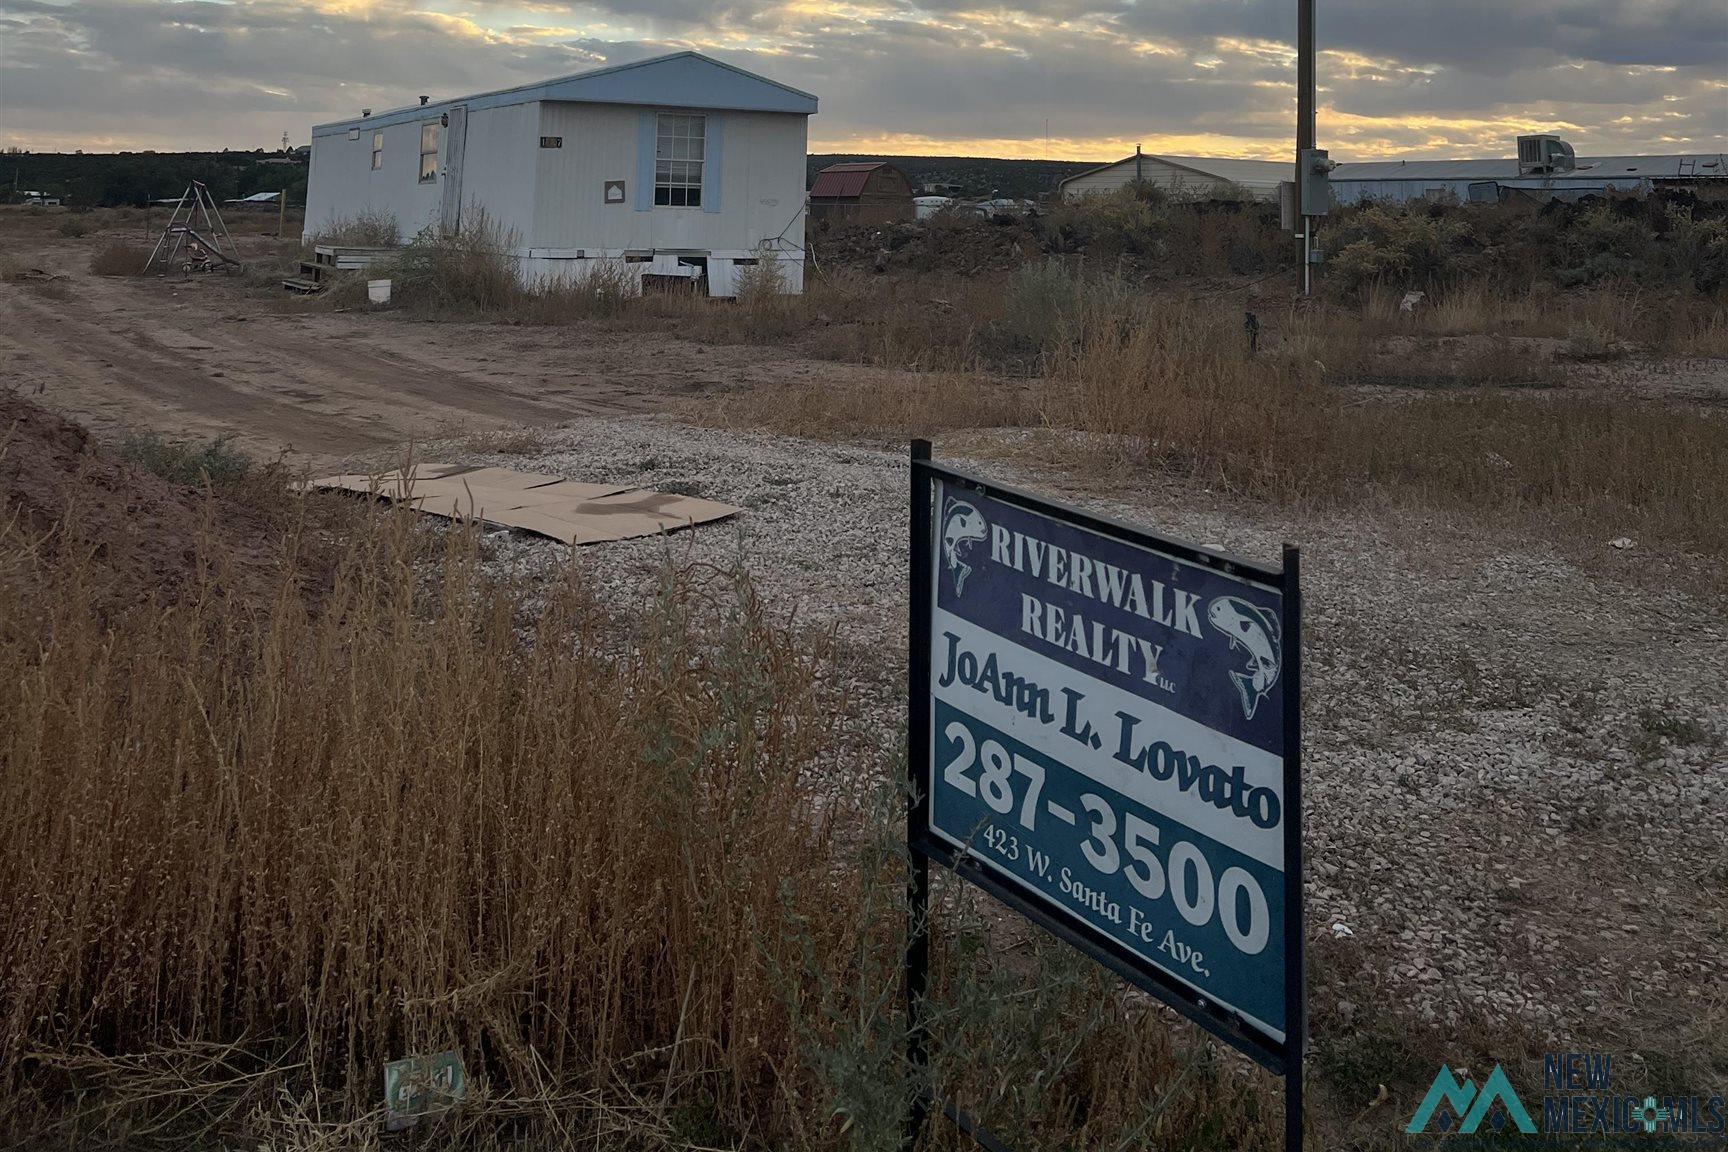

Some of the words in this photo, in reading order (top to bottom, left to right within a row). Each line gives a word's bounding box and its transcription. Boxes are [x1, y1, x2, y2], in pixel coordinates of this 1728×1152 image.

[990, 523, 1203, 639] RIVERWALK
[1021, 592, 1164, 685] REALTY
[938, 631, 1055, 724] JoAnn
[1060, 686, 1102, 750] L.
[1113, 710, 1281, 829] Lovato
[944, 721, 1270, 955] 287-3500
[983, 824, 1019, 861] 423
[1025, 844, 1053, 883] W.
[1059, 867, 1122, 925] Santa
[1127, 906, 1154, 943] Fe
[1157, 929, 1211, 978] Ave.
